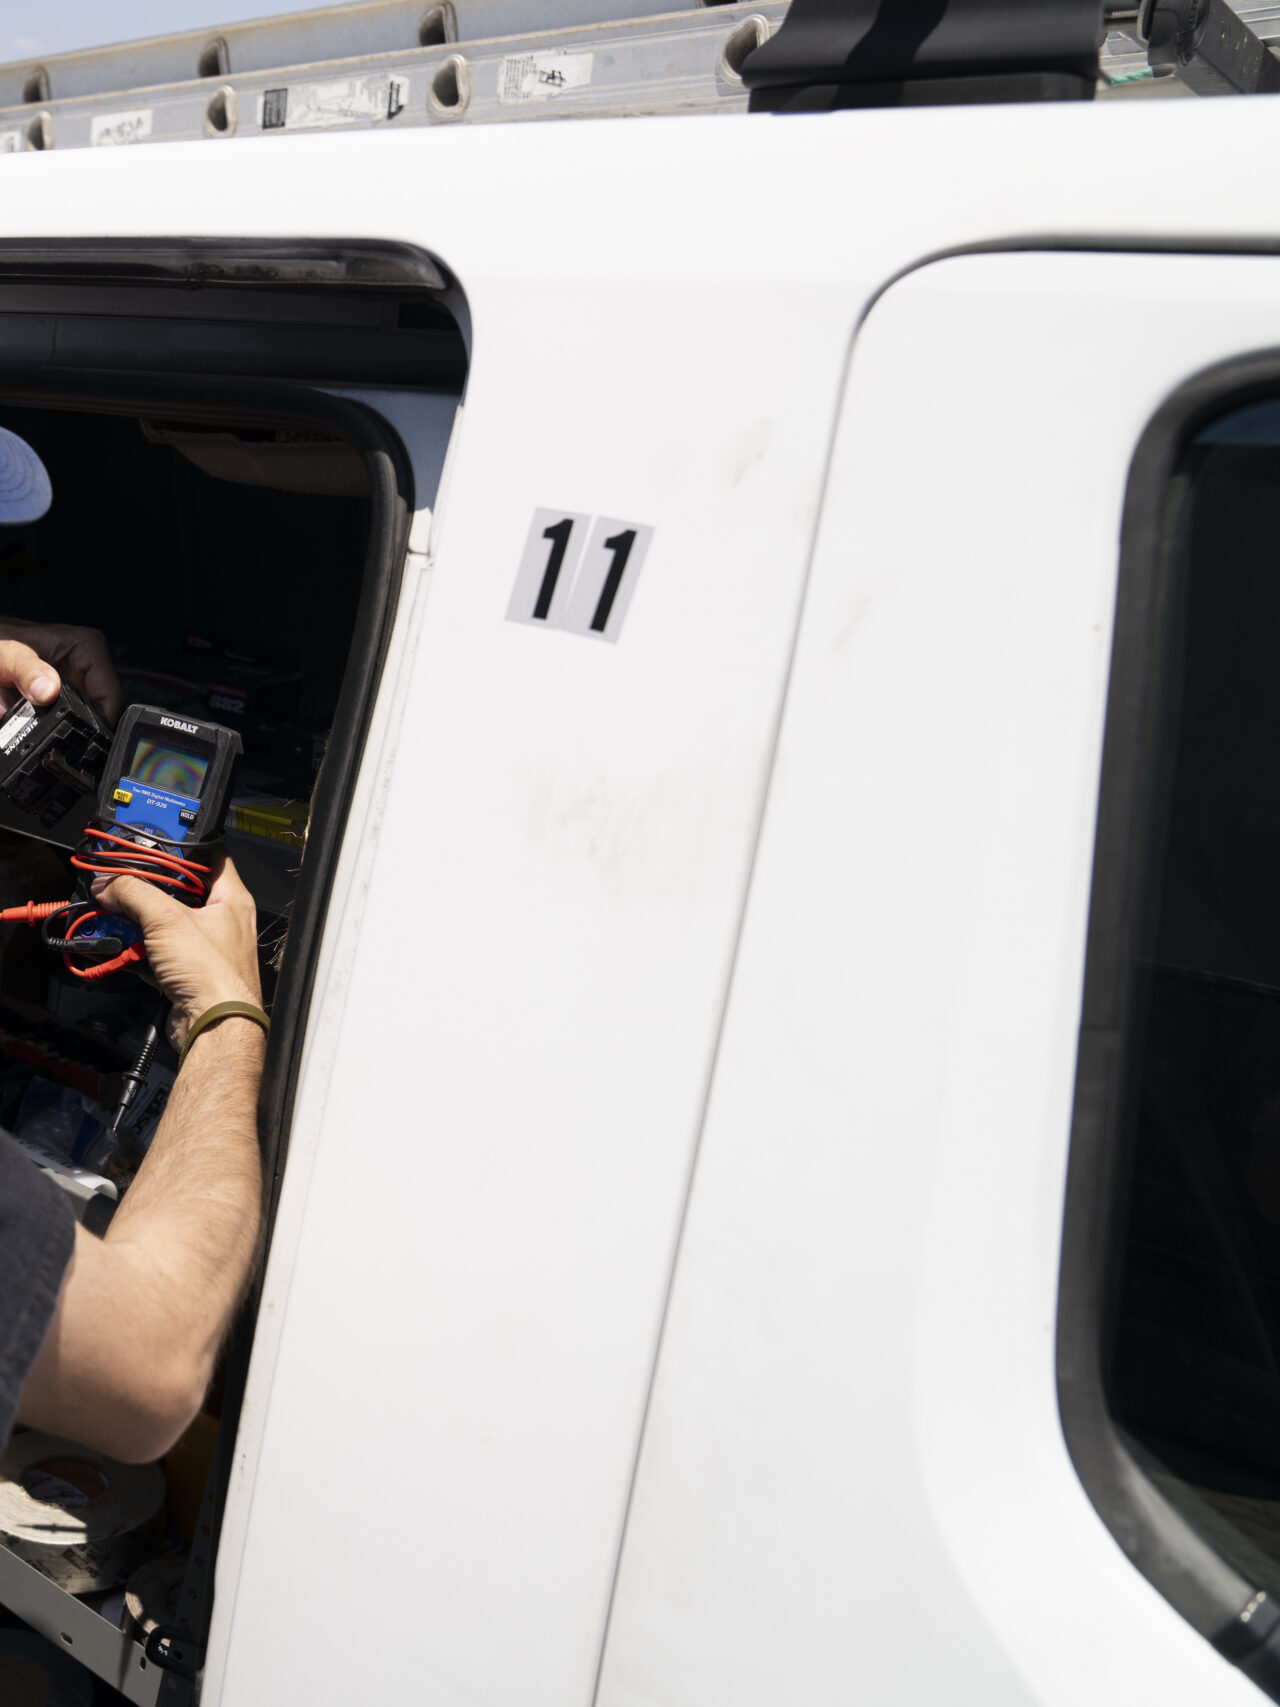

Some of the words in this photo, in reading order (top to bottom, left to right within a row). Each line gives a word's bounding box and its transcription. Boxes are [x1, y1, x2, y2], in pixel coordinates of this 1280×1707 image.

[532, 518, 638, 633] 11
[4, 718, 40, 756] SIEMENS
[160, 716, 199, 734] KOBALT
[146, 798, 168, 809] DT-926
